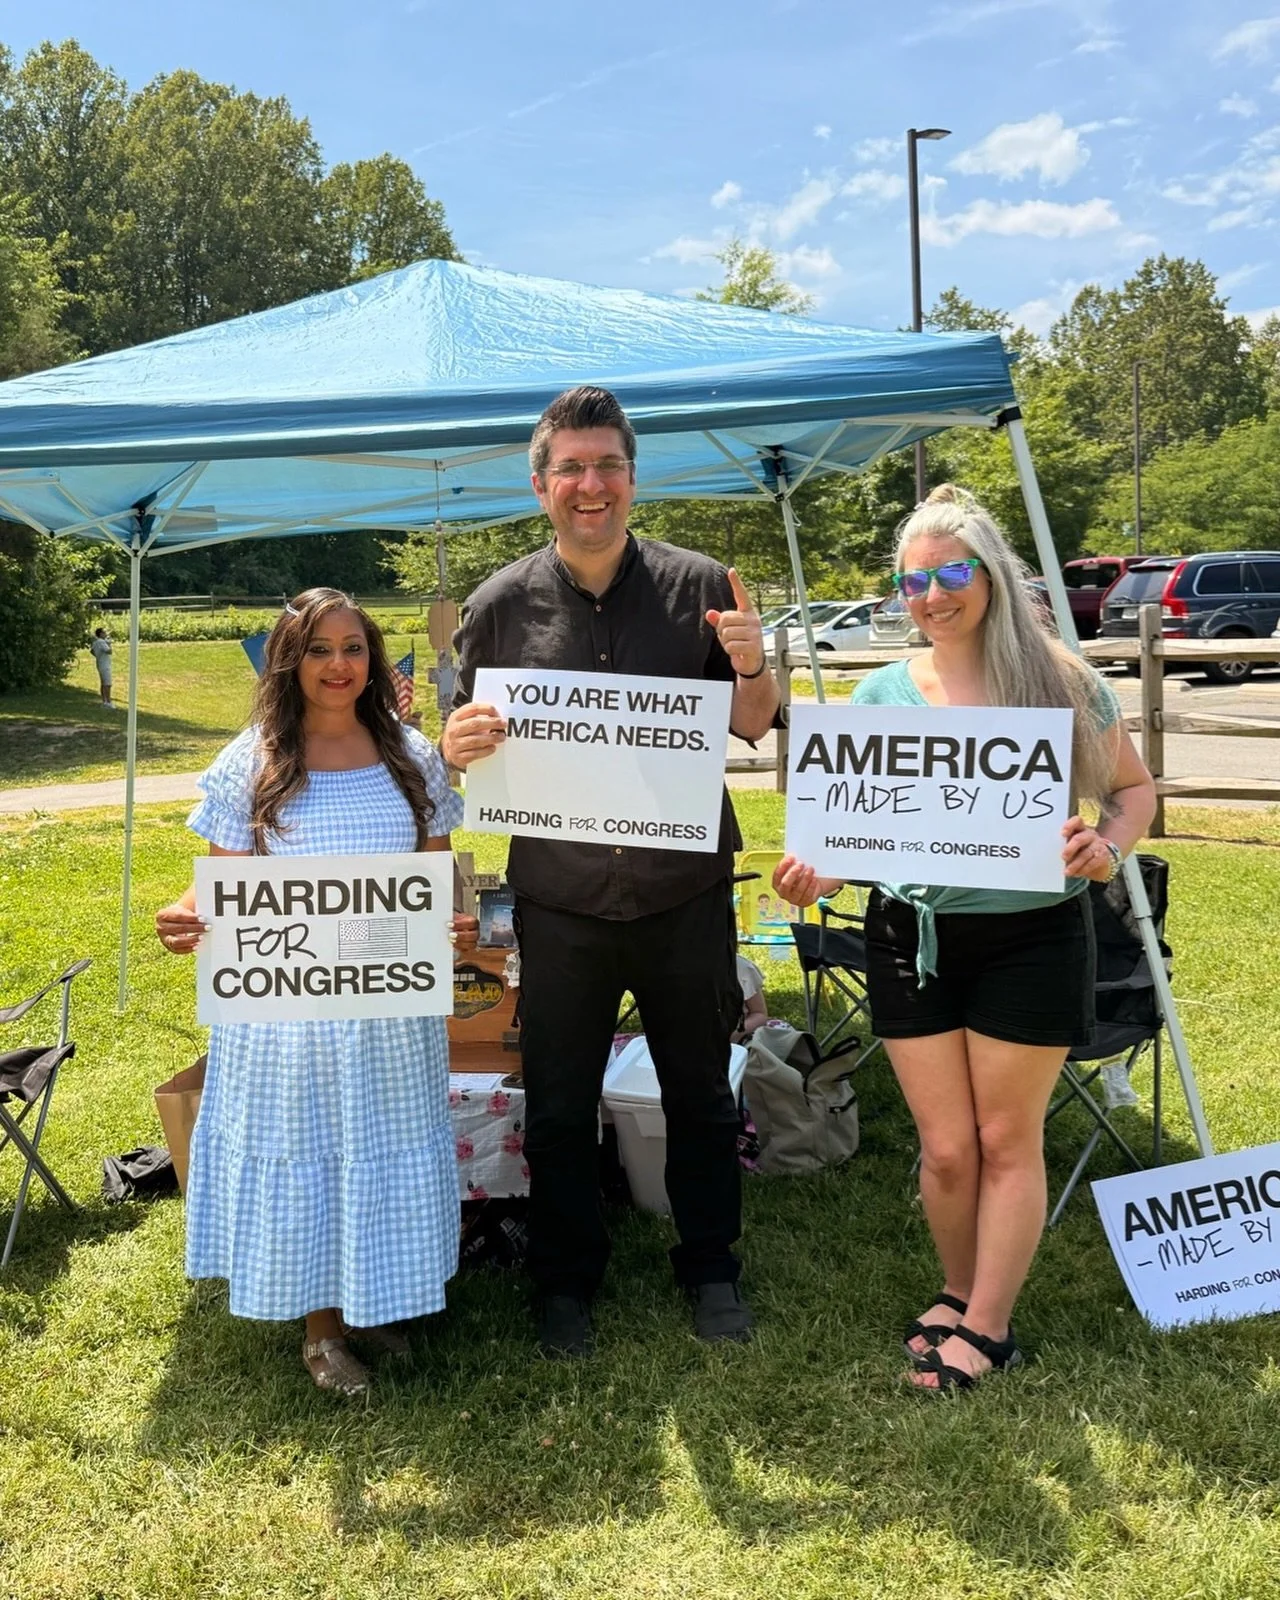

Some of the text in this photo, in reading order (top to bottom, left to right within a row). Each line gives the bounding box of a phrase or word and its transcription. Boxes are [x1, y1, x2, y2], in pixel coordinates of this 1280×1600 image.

[505, 683, 703, 716] YOU ARE WHAT
[506, 717, 710, 752] MERICA NEEDS.
[796, 733, 1063, 782] AMERICA
[939, 784, 981, 815] BY
[1002, 788, 1055, 819] US
[479, 807, 707, 841] HARDING FOR CONGRESS
[825, 836, 1021, 859] HARDING FOR CONGRESS
[214, 875, 433, 917] HARDING
[235, 922, 317, 962] FOR
[212, 960, 436, 999] CONGRESS
[1239, 1216, 1272, 1243] BY
[1175, 1281, 1231, 1303] HARDING
[1232, 1276, 1254, 1290] FOR
